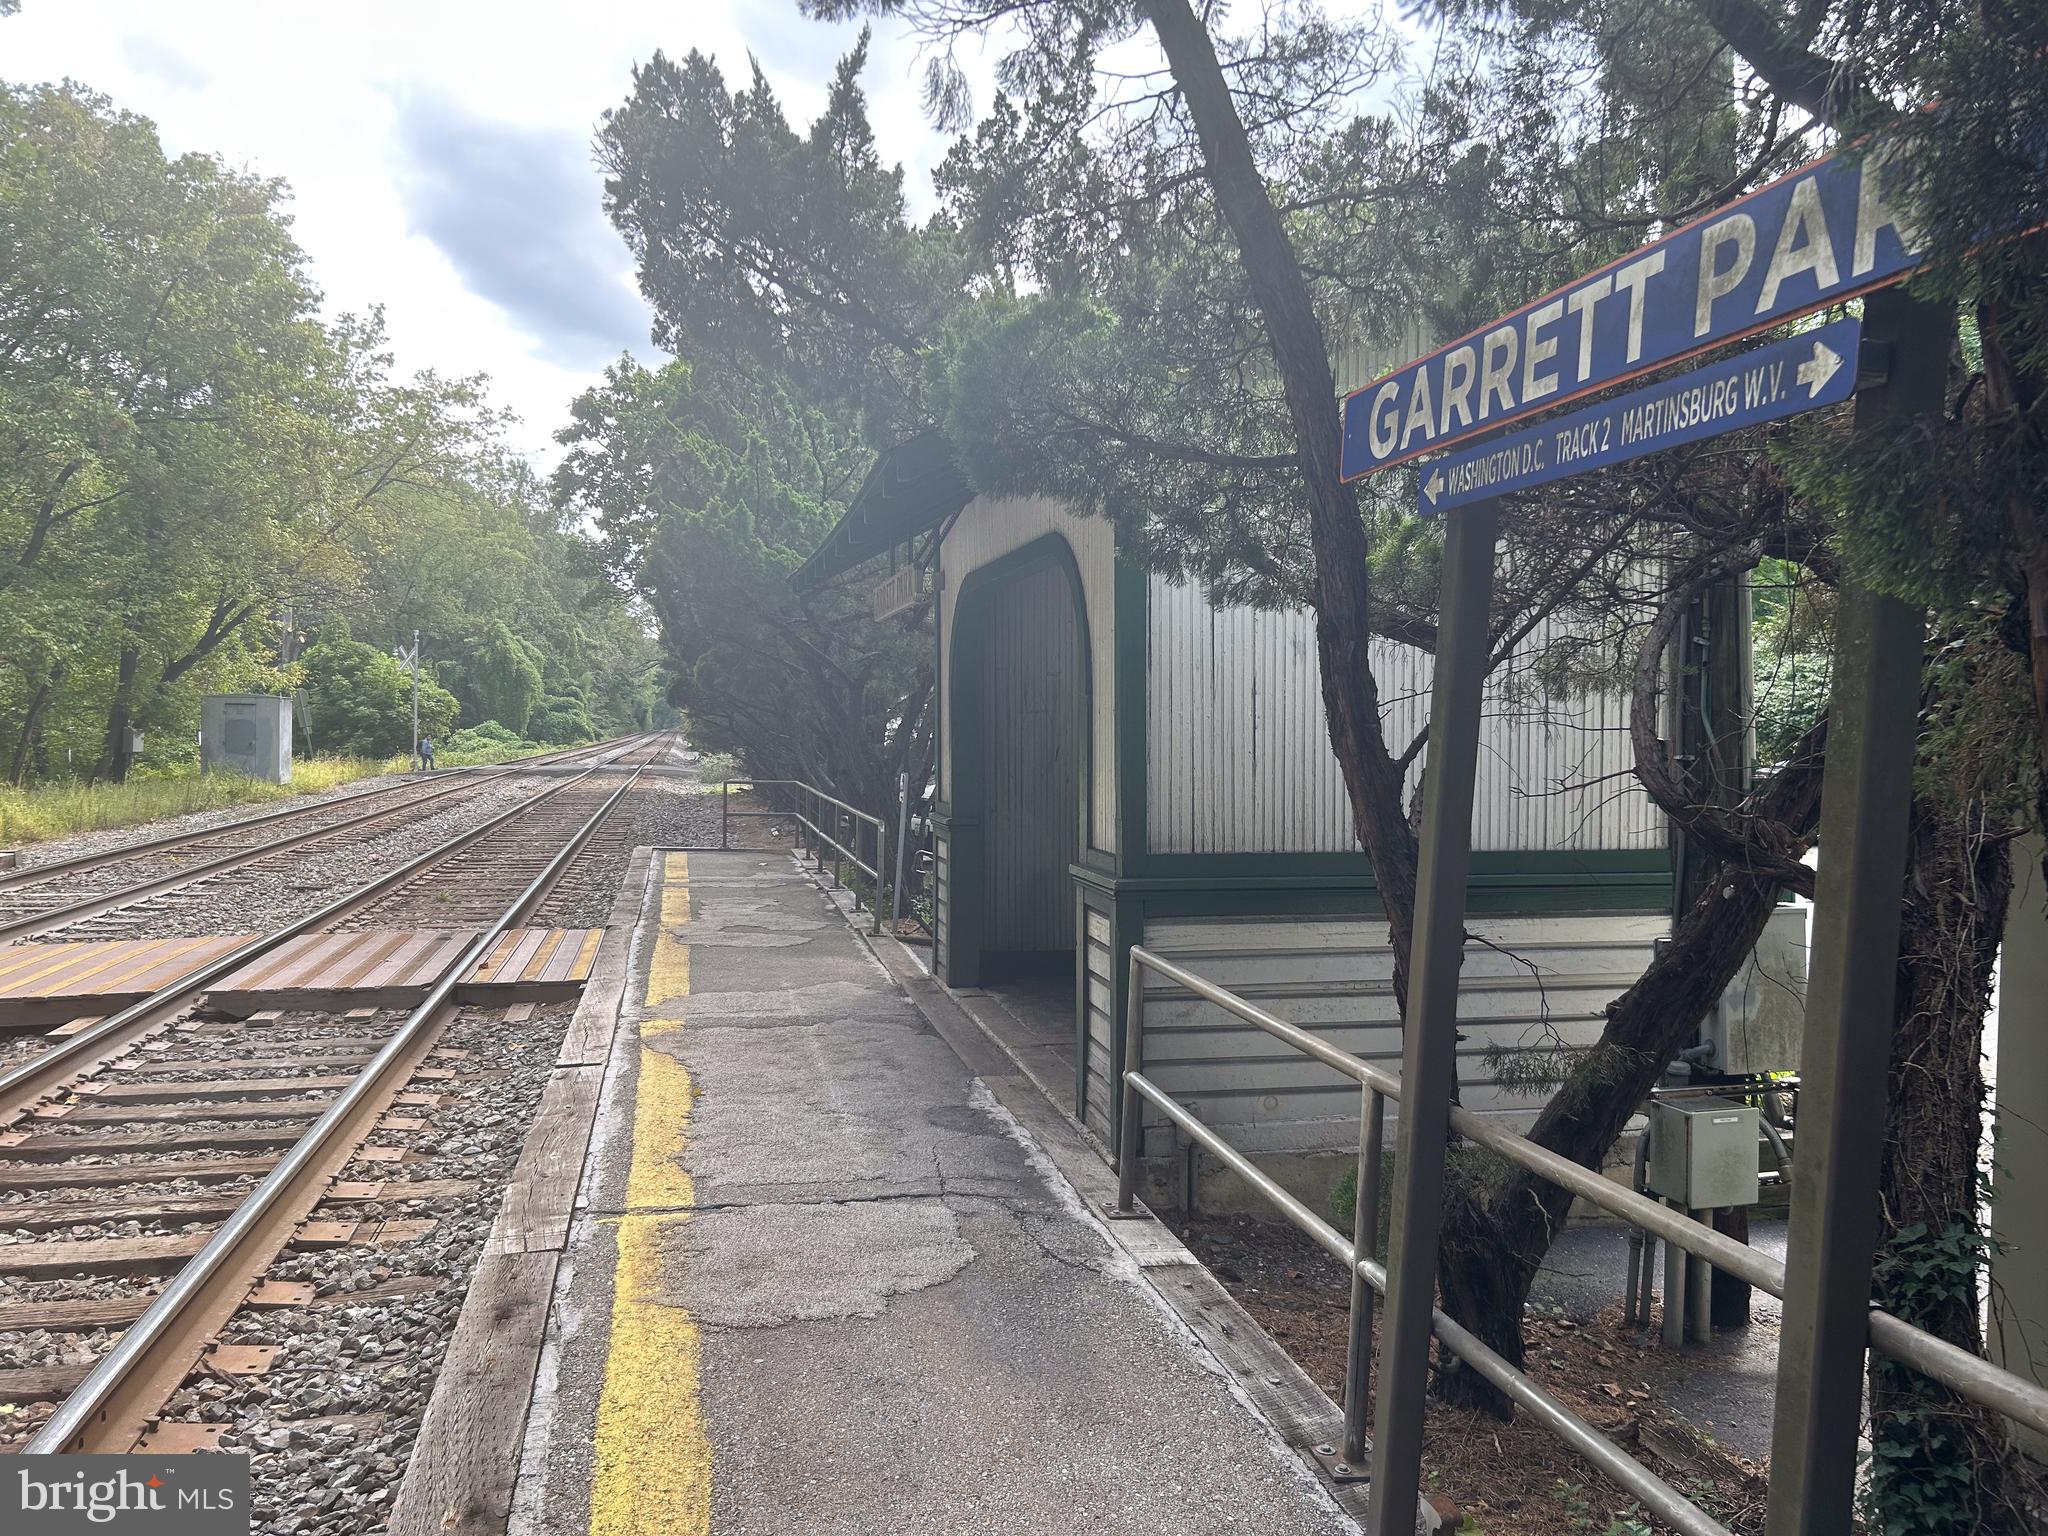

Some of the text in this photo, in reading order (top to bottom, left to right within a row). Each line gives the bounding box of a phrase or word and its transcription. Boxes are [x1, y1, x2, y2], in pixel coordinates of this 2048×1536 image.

[1368, 135, 1934, 460] GARRETT PAR
[1448, 360, 1786, 496] WASHINGTON D.C. TRACK 2 MARTINSBURG W.V.
